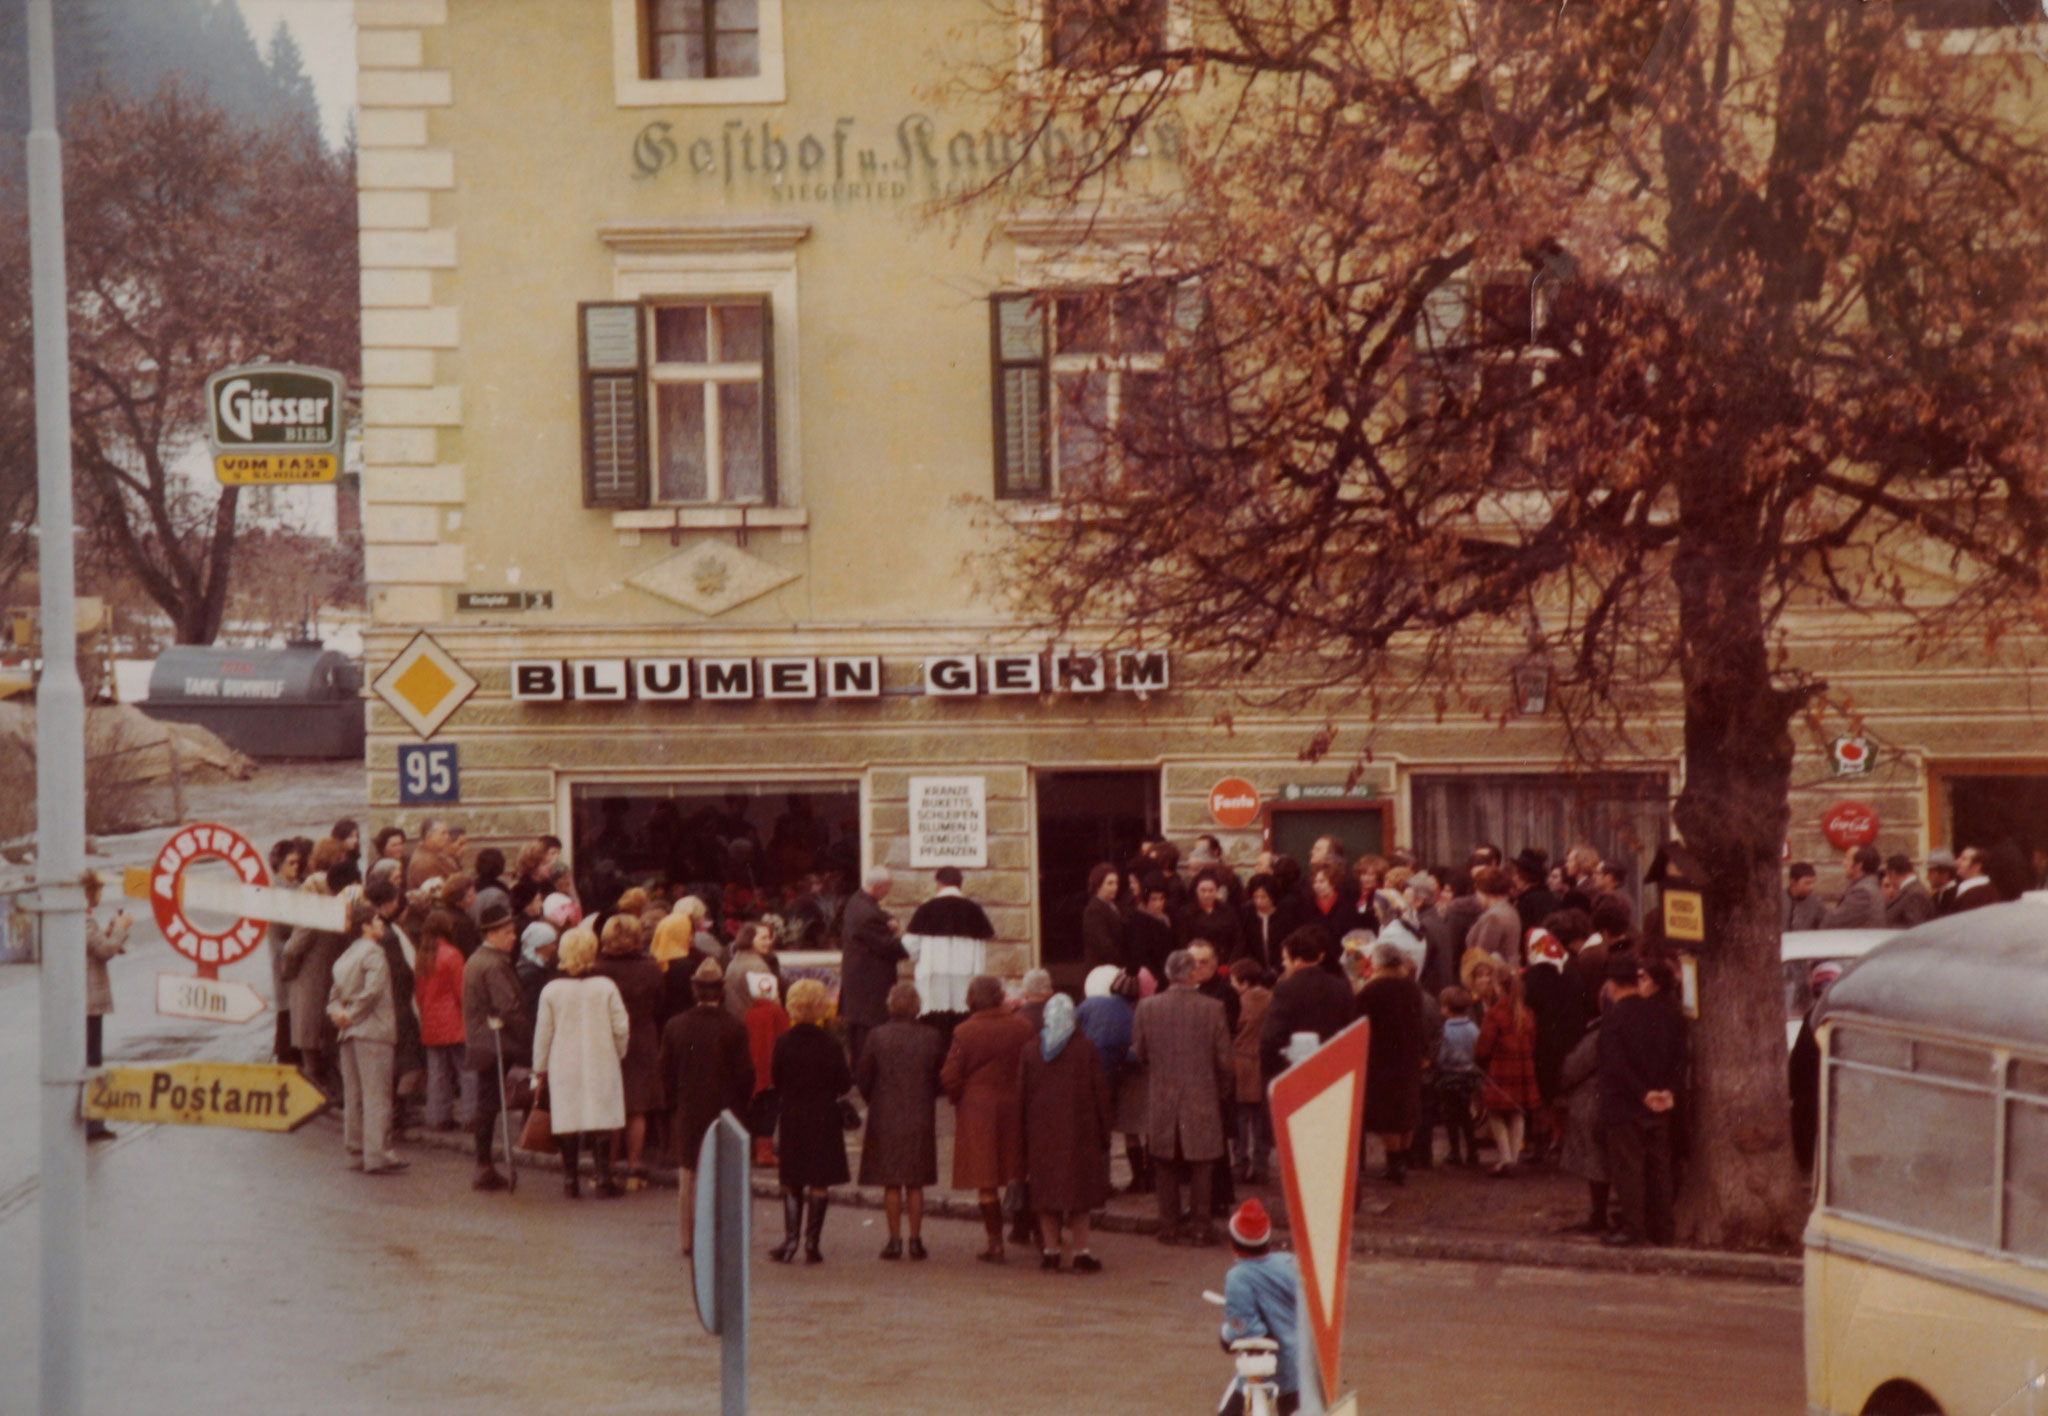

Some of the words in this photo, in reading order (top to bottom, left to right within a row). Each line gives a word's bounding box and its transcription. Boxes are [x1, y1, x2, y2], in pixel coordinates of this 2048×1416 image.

[892, 113, 1181, 181] Kaufhas
[219, 379, 328, 441] Gösser
[285, 427, 327, 441] BIER
[222, 459, 268, 470] VOM
[278, 458, 329, 469] FASS
[253, 471, 320, 479] SCHILLER
[185, 677, 219, 696] TANK
[517, 662, 872, 694] BLUMEN
[930, 653, 1164, 690] GERM
[406, 751, 451, 795] 95
[153, 827, 261, 899] AUSTRIA
[166, 914, 260, 962] TABAK
[92, 1084, 142, 1108] Zum
[150, 1071, 291, 1116] Postamt
